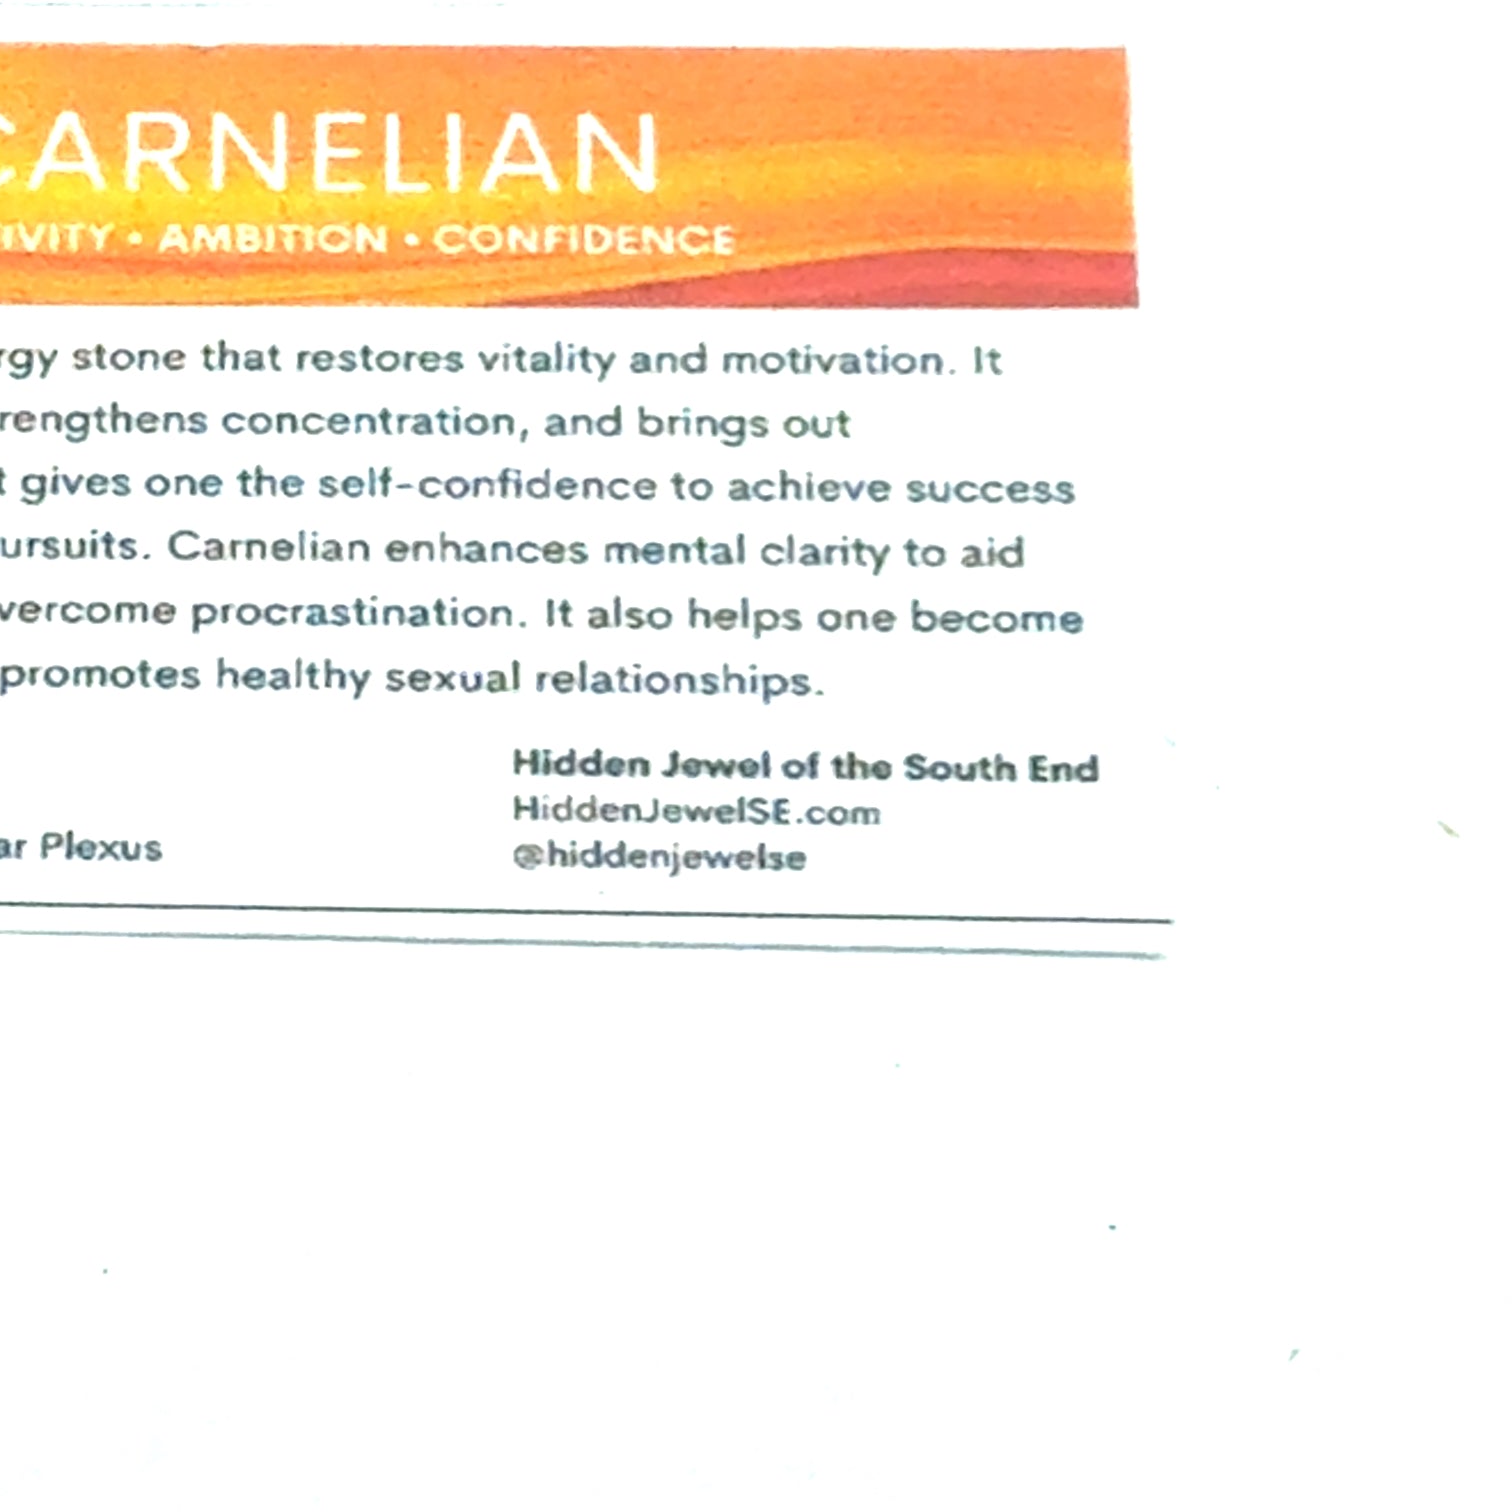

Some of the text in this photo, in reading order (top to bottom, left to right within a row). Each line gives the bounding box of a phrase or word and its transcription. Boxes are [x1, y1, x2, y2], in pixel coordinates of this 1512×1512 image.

[158, 221, 388, 254] AMBITION
[434, 223, 735, 257] CONFIDENCE
[71, 343, 187, 372] stone
[200, 338, 283, 372] that
[296, 344, 465, 374] restores
[477, 340, 617, 383] vitality
[629, 341, 708, 375] and
[722, 343, 956, 376] motivation.
[973, 345, 1003, 376] It
[221, 405, 529, 444] concentration,
[544, 404, 623, 438] and
[637, 405, 770, 448] brings
[782, 409, 852, 440] out
[19, 465, 132, 506] gives
[143, 473, 224, 498] one
[235, 464, 306, 499] the
[318, 465, 658, 501] self-confidence
[669, 471, 714, 502] to
[727, 468, 893, 503] achieve
[906, 479, 1076, 505] success
[167, 529, 371, 563] Carnelian
[383, 530, 590, 565] enhances
[604, 532, 746, 566] mental
[760, 533, 892, 577] clarity
[902, 538, 947, 568] to
[960, 535, 1025, 569] aid
[191, 594, 527, 635] procrastination.
[546, 598, 574, 628] It
[587, 595, 674, 631] also
[687, 596, 803, 640] helps
[816, 608, 898, 633] one
[910, 598, 1085, 635] become
[216, 656, 372, 701] healthy
[385, 659, 521, 694] sexual
[535, 659, 825, 706] relationships.
[512, 747, 1100, 784] Hidden Jewel of the South End
[513, 794, 881, 827] HiddenJewelSE.com
[39, 829, 164, 863] Plexus
[513, 838, 808, 878] @hiddenjewelse
